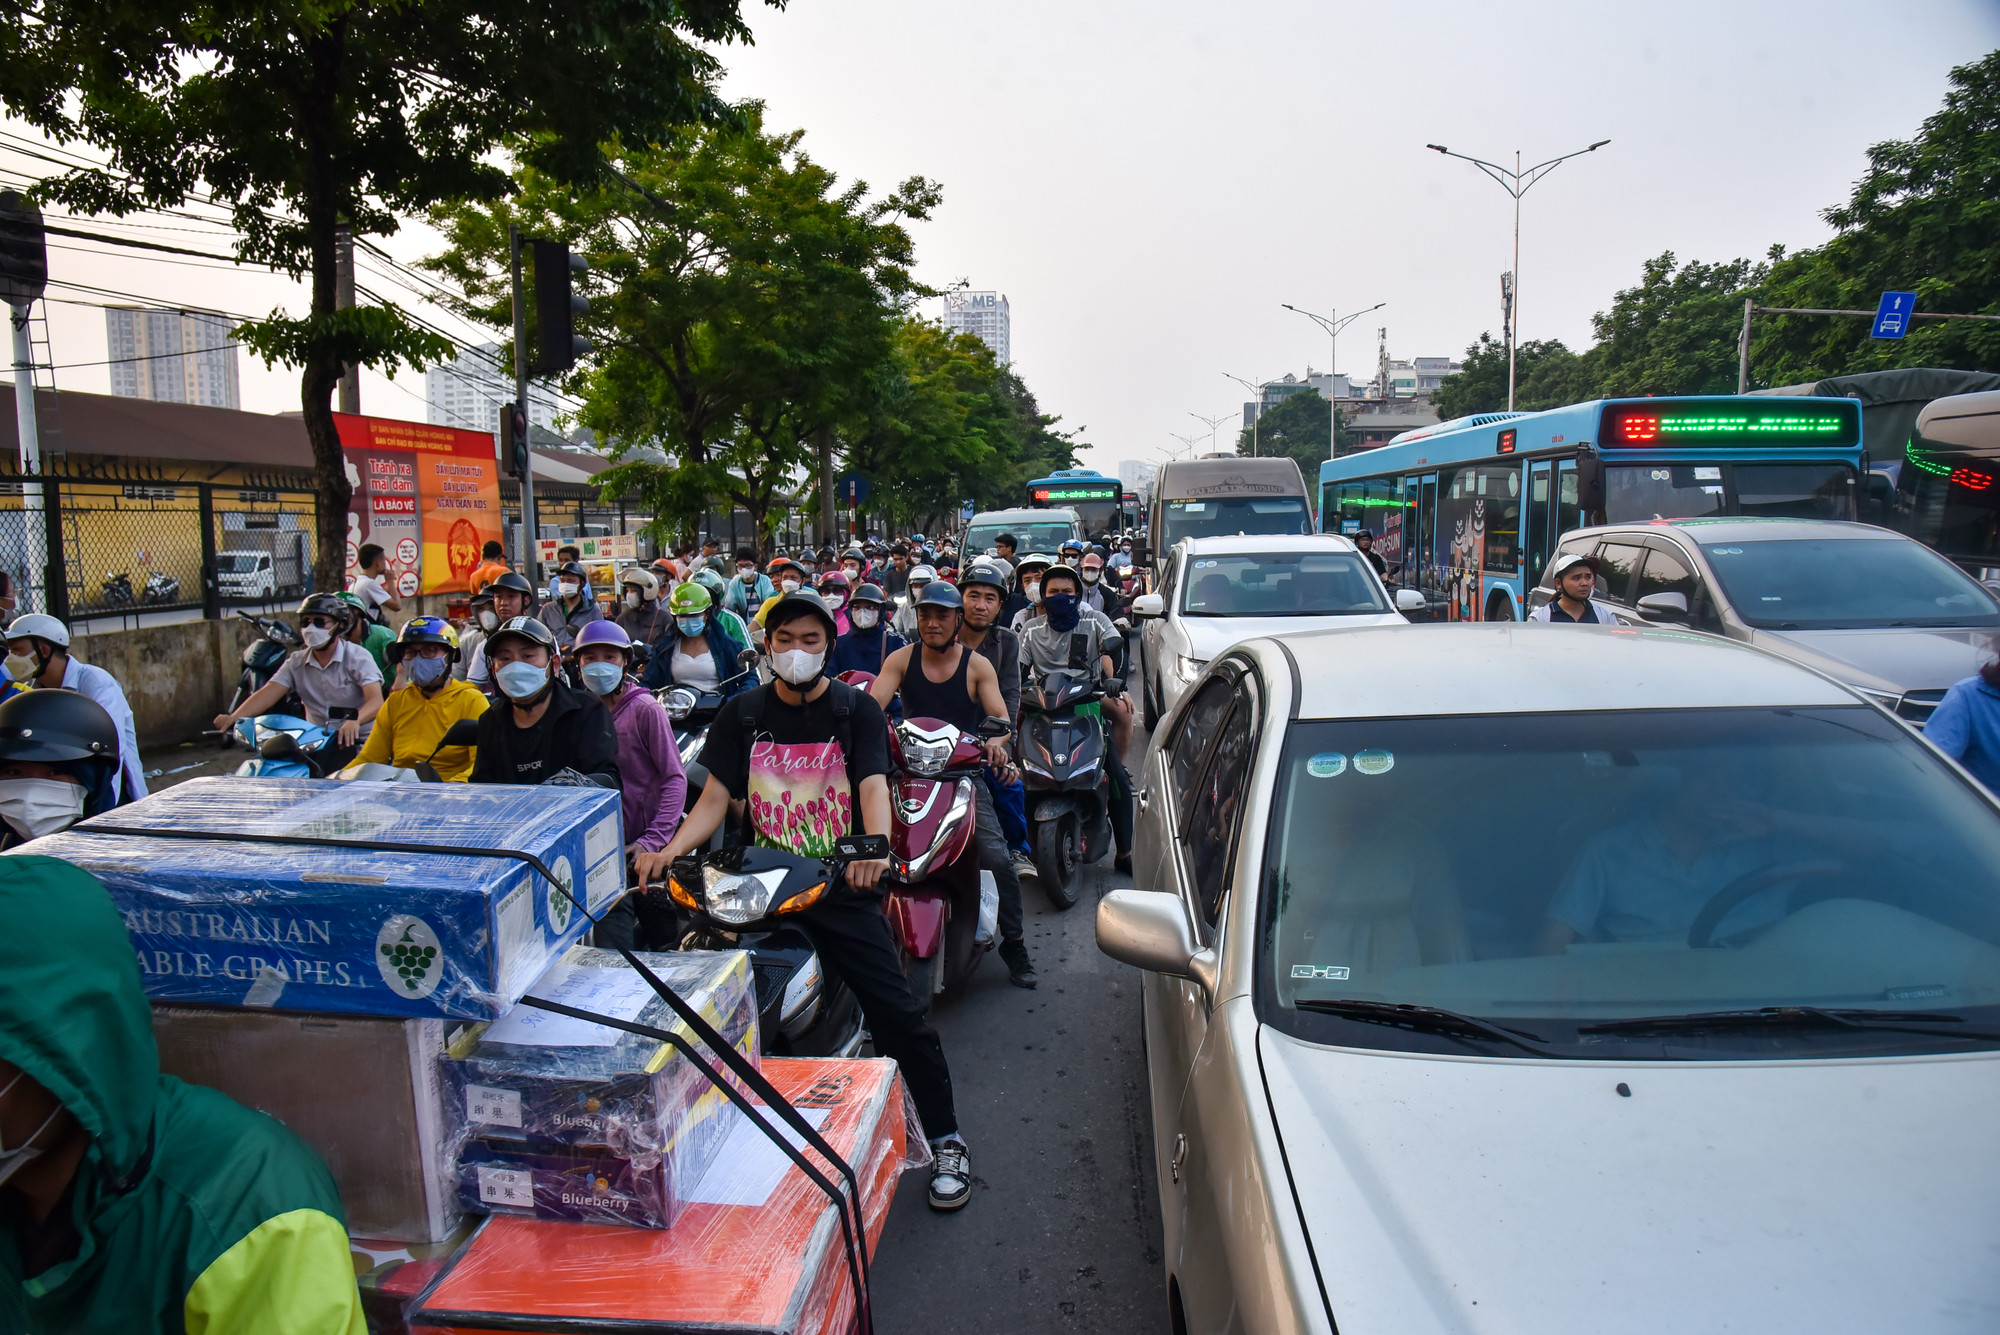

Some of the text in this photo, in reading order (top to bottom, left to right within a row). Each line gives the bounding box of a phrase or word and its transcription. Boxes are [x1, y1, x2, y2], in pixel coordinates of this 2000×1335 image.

[972, 295, 995, 308] MB
[375, 437, 386, 446] BAN
[368, 458, 412, 476] Tránh xa
[460, 466, 471, 476] MA
[392, 476, 414, 492] dâm
[468, 483, 478, 493] HIV
[374, 498, 385, 510] LÀ
[386, 496, 403, 510] BẢO
[473, 499, 487, 510] AIDS
[541, 540, 556, 549] BÁNH
[584, 540, 596, 555] NGÔ
[600, 538, 612, 546] LUỘC
[602, 548, 612, 556] XÀO
[124, 908, 332, 946] AUSTRALIAN
[136, 950, 350, 987] ABLE GRAPES
[562, 1193, 630, 1213] Blueberry
